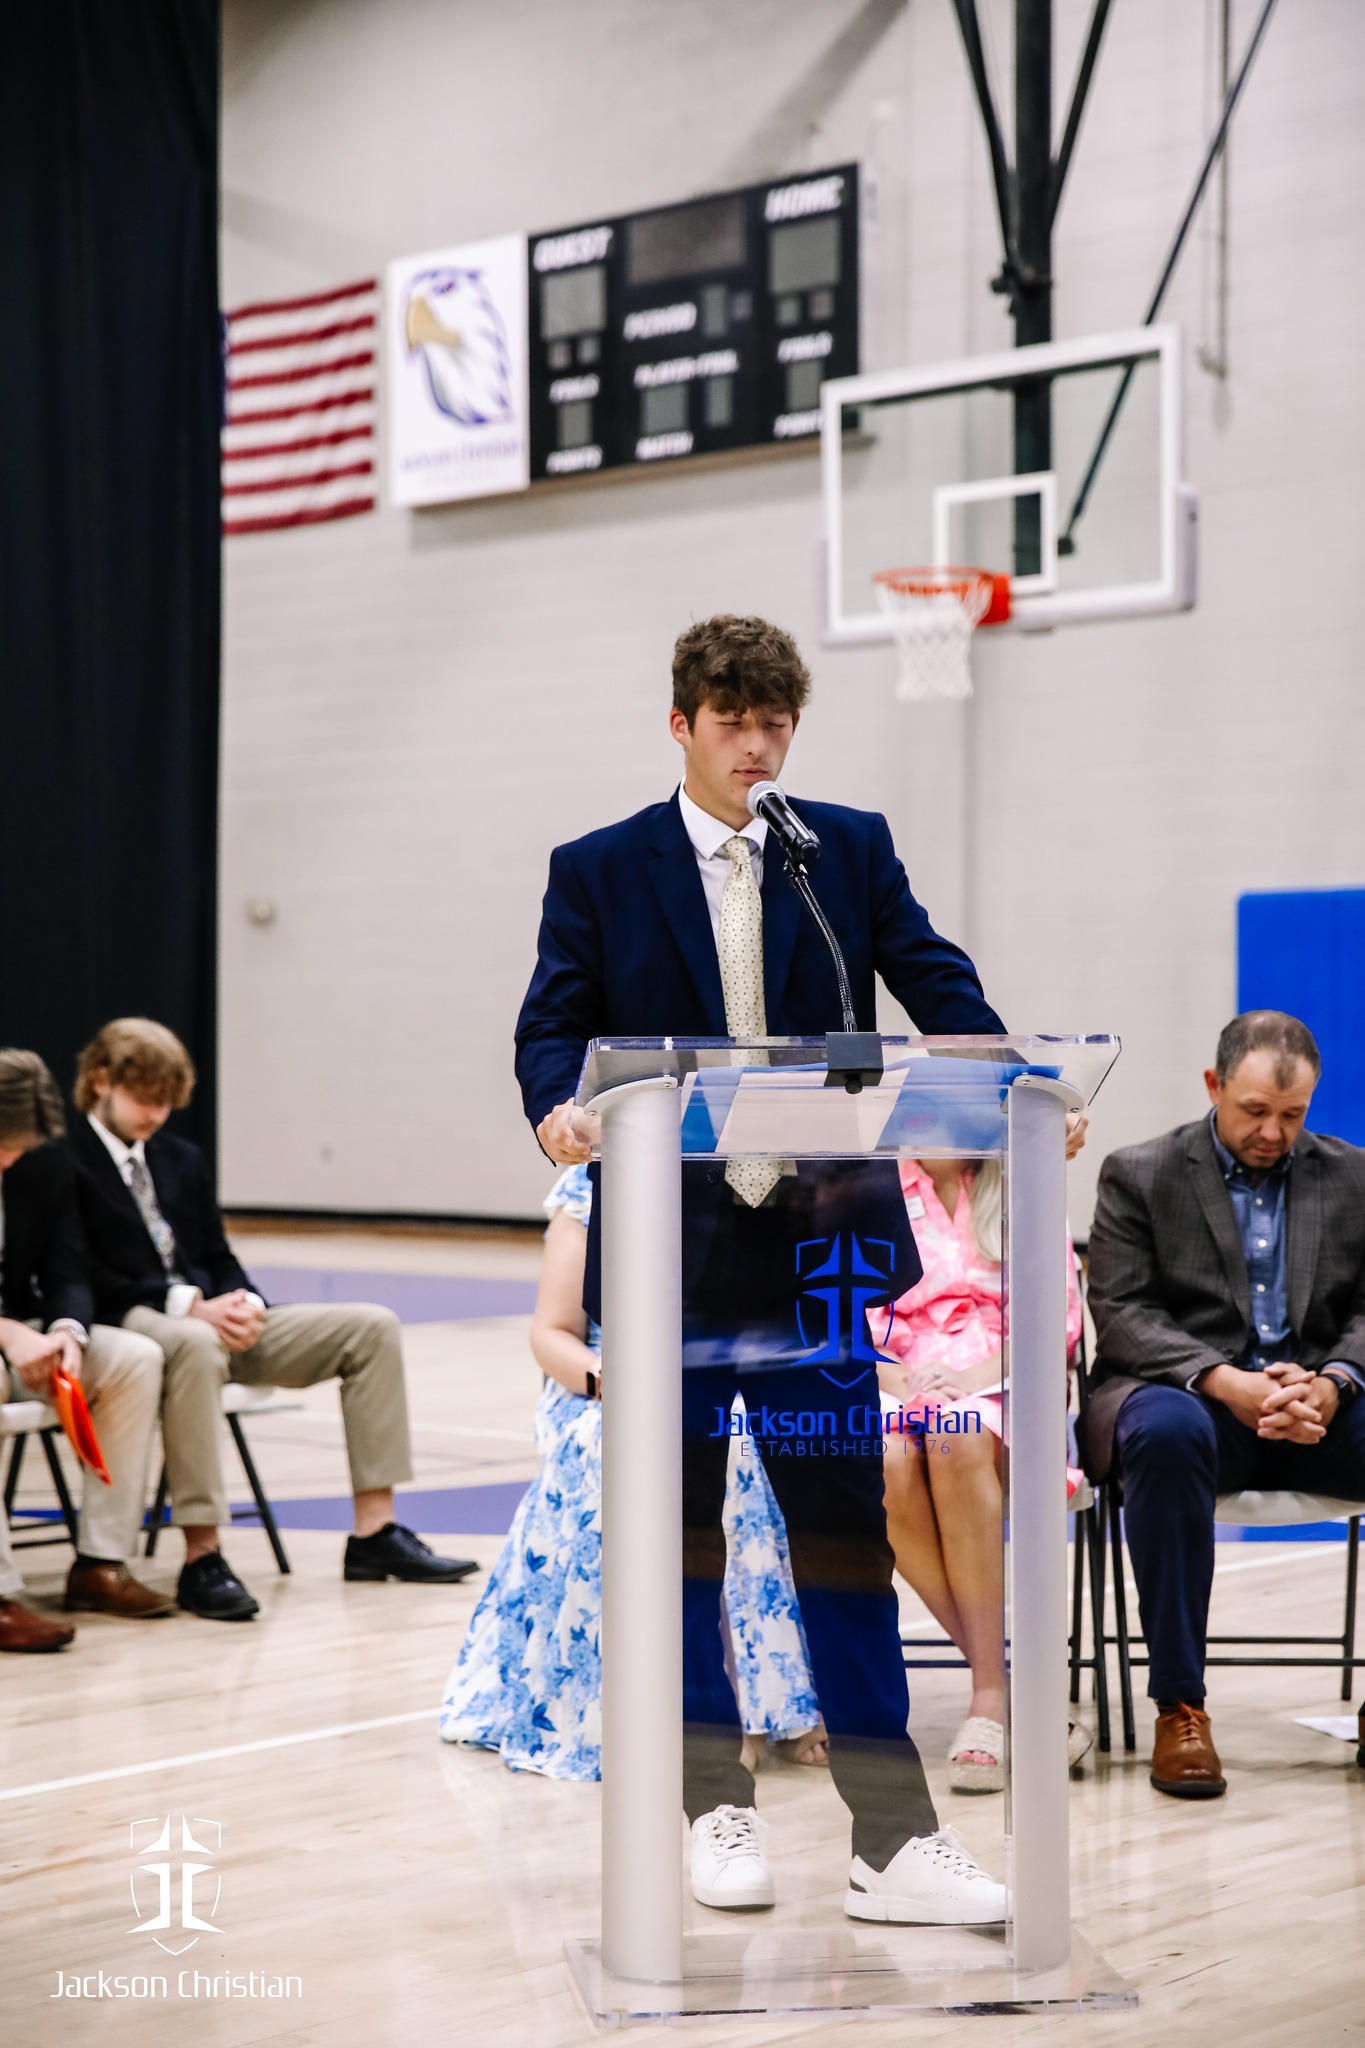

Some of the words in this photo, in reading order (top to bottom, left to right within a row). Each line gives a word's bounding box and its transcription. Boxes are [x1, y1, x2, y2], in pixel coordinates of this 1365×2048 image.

[765, 176, 844, 223] HOME
[534, 226, 613, 272] GUEST
[709, 1406, 836, 1437] Jackson
[848, 1404, 982, 1435] Christian
[741, 1440, 888, 1457] ESTABLISHED
[904, 1439, 951, 1455] 1976
